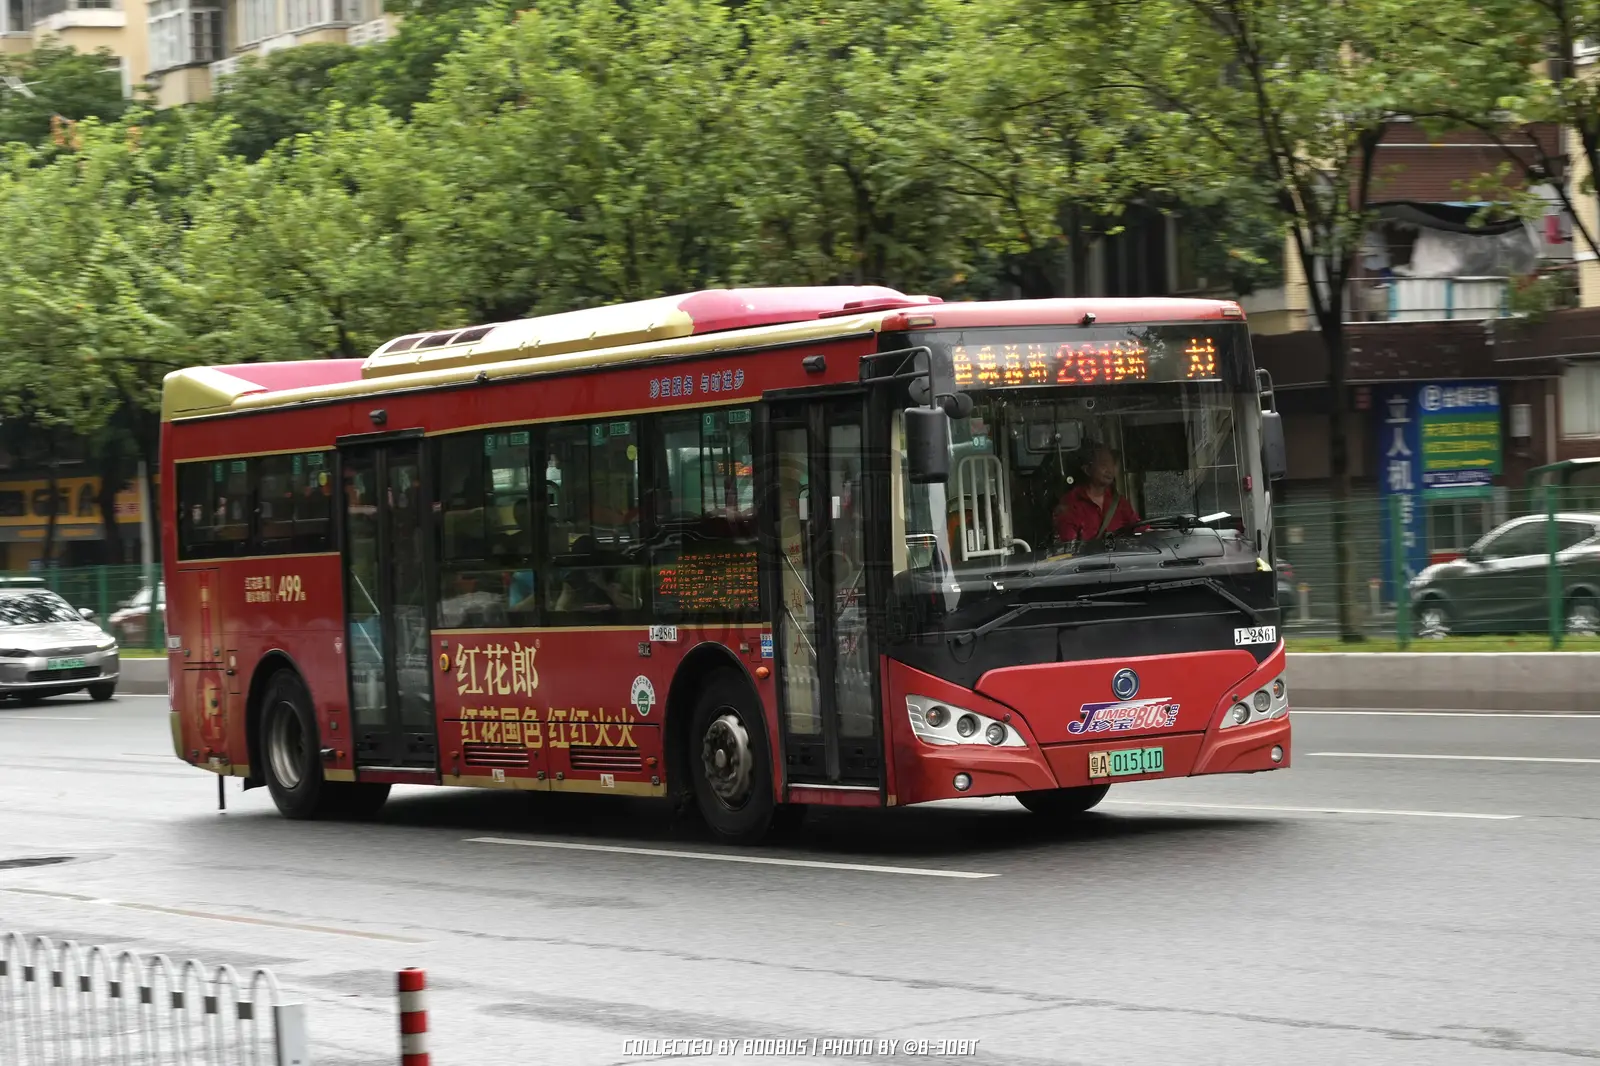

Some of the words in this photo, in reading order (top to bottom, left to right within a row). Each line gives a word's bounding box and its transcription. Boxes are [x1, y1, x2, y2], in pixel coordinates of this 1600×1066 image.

[651, 376, 693, 398] 珍宝服务
[700, 369, 744, 392] 与时进步
[651, 627, 676, 640] J-2861
[1235, 628, 1276, 644] J-2861
[455, 642, 539, 697] 红花郎
[460, 707, 543, 748] 红花国色
[548, 708, 637, 748] 红红火火
[1091, 719, 1134, 732] 珍宝
[1133, 704, 1169, 730] BUS
